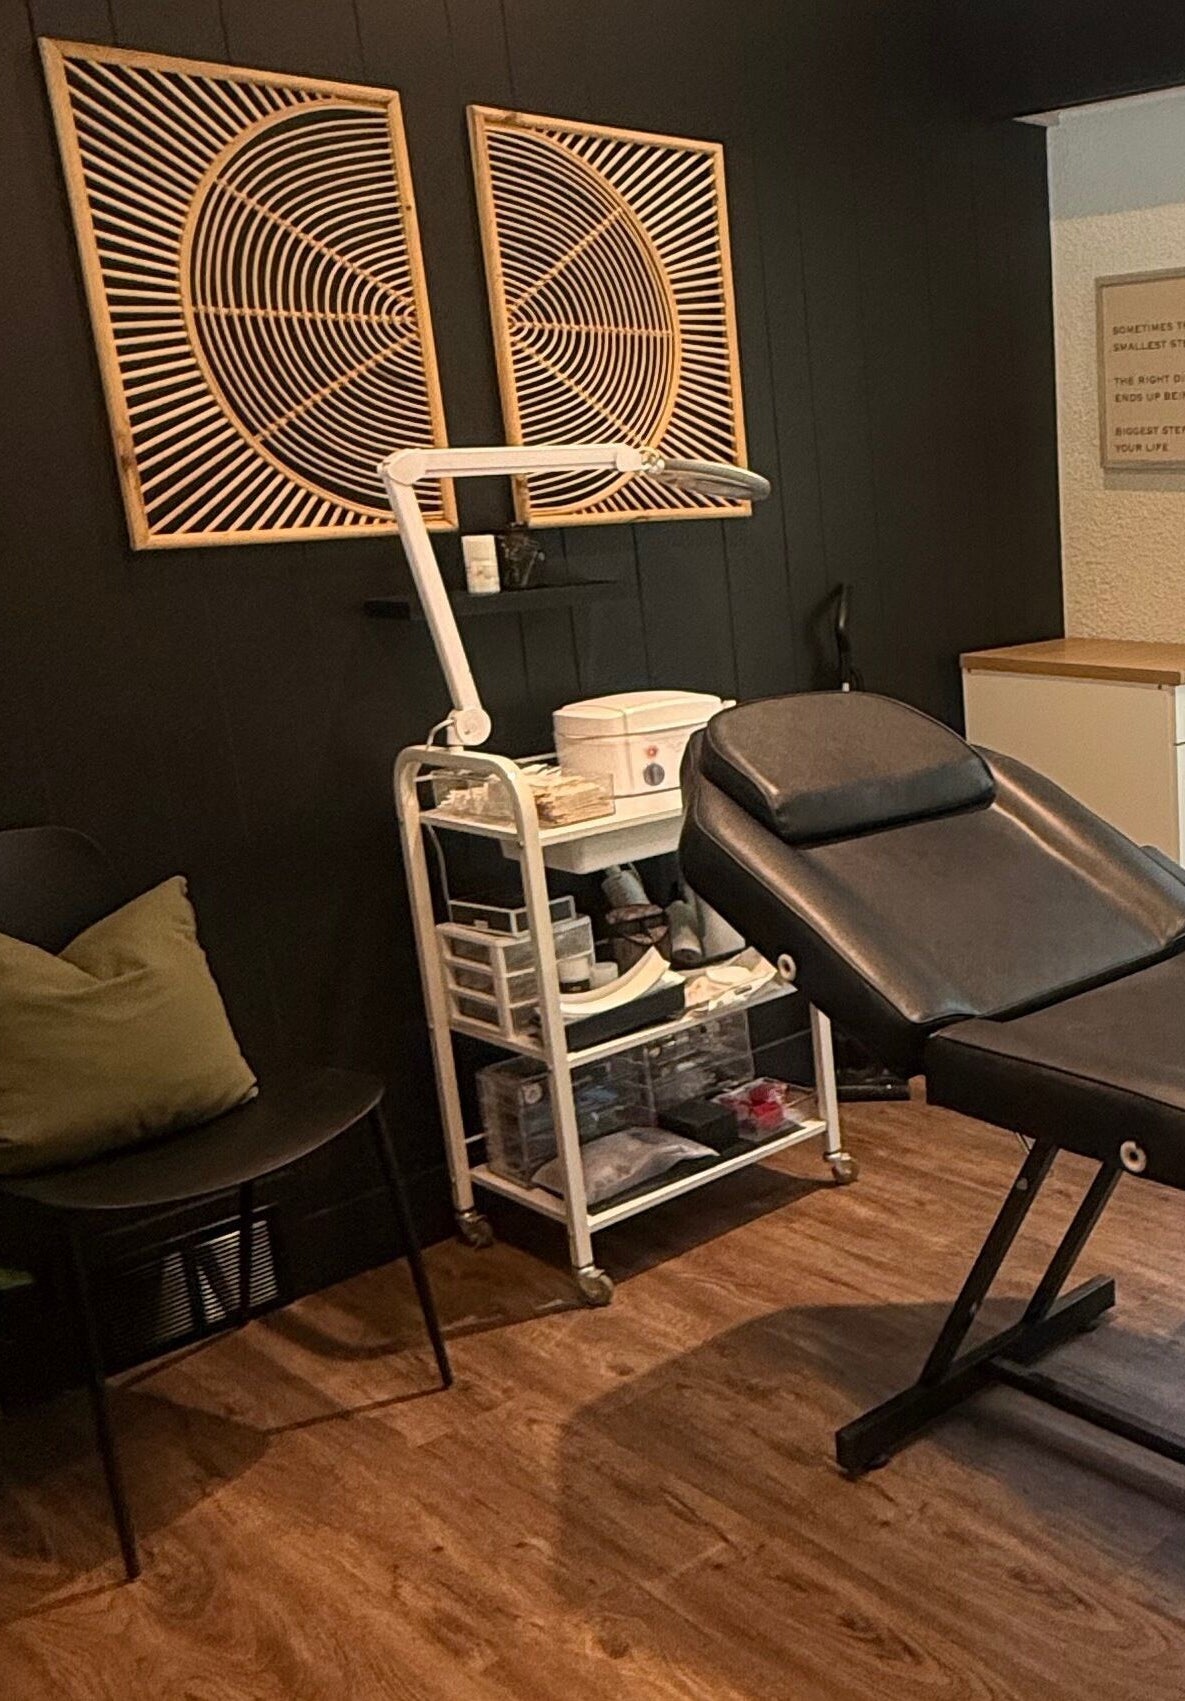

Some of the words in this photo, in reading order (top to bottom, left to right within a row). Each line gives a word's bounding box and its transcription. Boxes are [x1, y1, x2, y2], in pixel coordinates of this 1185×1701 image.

[1113, 322, 1173, 335] SOMETIMES
[1113, 340, 1167, 352] SMALLEST
[1114, 376, 1133, 387] THE
[1138, 374, 1170, 385] RIGHT
[1115, 393, 1142, 403] ENDS
[1146, 392, 1161, 402] UP
[1115, 426, 1159, 436] BIGGEST
[1114, 443, 1142, 453] YOUR
[1146, 443, 1169, 453] LIFE
